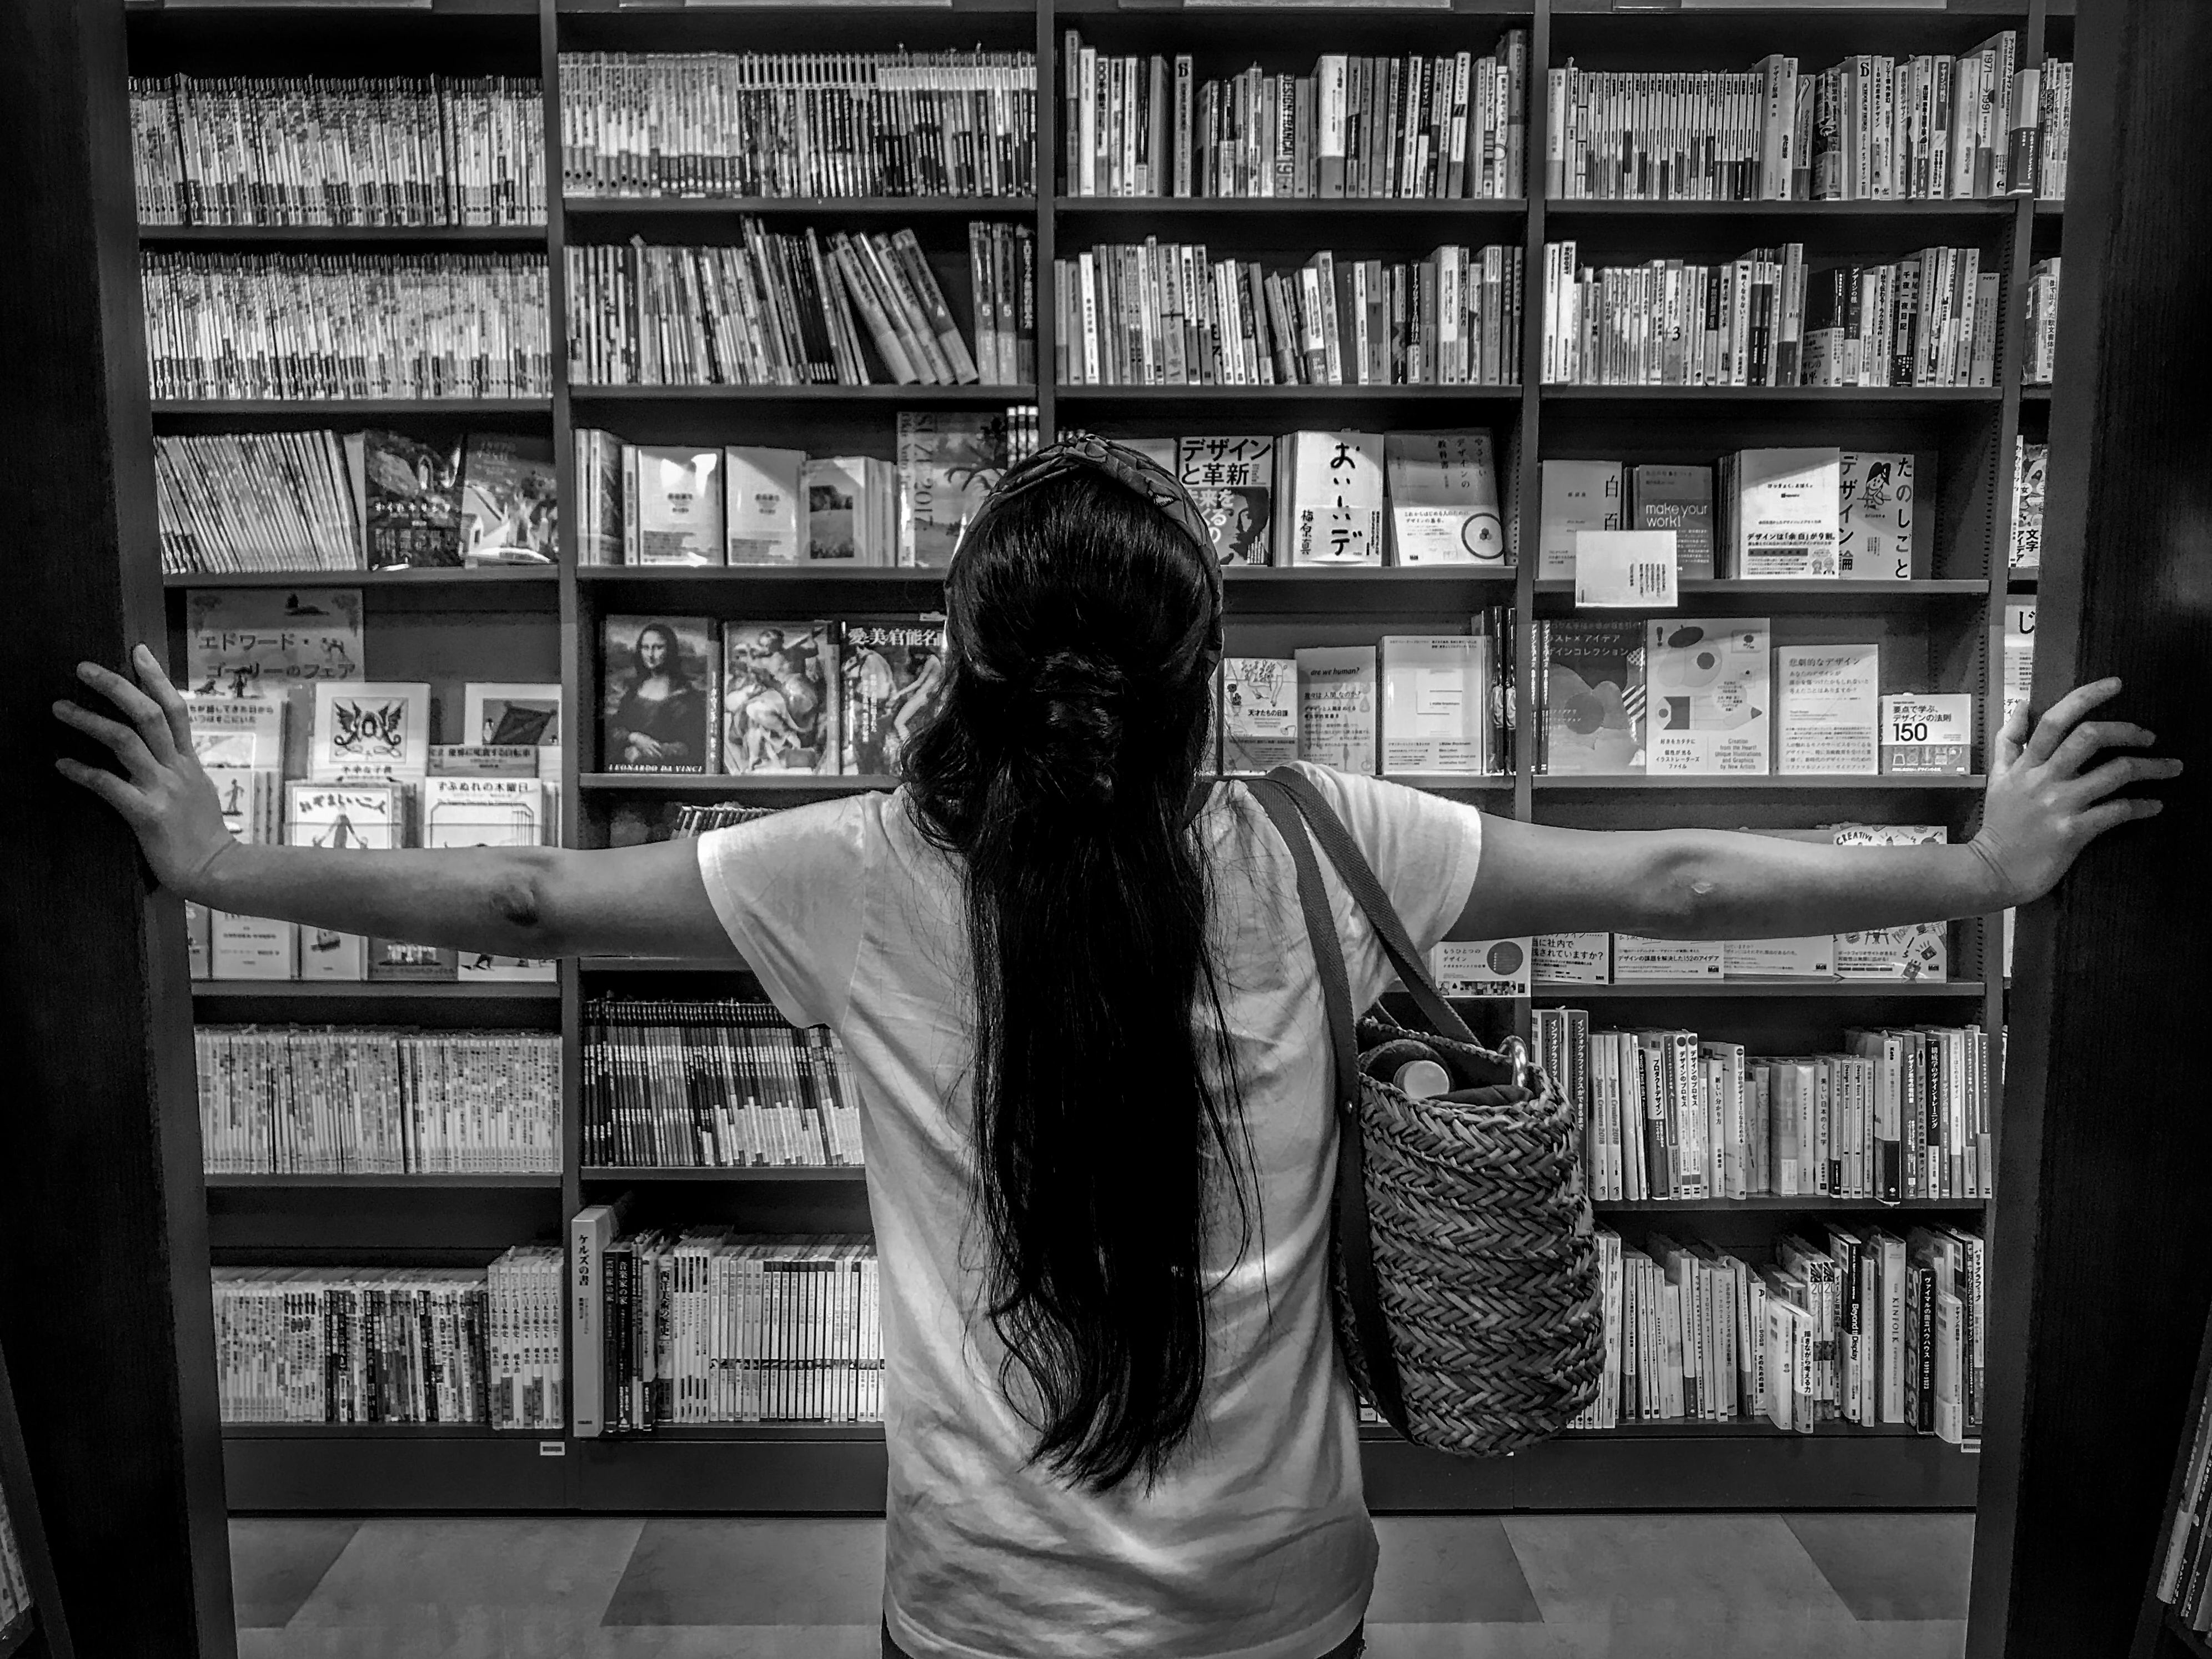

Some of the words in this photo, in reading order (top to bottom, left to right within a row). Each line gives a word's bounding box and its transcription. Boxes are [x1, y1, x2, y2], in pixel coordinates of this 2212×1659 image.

[1983, 53, 1993, 73] 1971
[1182, 438, 1271, 462] デザイン
[1181, 462, 1250, 486] と革新
[1646, 502, 1679, 515] make
[1681, 504, 1708, 518] your
[1646, 515, 1681, 527] work!
[1895, 457, 1913, 579] たのしごと
[2026, 529, 2039, 552] 文字
[199, 632, 309, 652] エドワード・
[1789, 658, 1860, 666] 悲劇的なデザイン
[1893, 705, 1938, 713] 要点で学ぶ、
[1893, 713, 1952, 722] デザインの法則
[1893, 723, 1928, 742] 150
[675, 764, 703, 773] VINCI
[1595, 1077, 1604, 1097] Japan
[1609, 1077, 1617, 1098] Japan
[1653, 1059, 1662, 1116] プロダクトデザイン
[1679, 1051, 1688, 1107] デザインのプロセス
[1690, 1050, 1698, 1106] デザインのプロセス
[1597, 1099, 1605, 1127] Creators
[578, 1234, 589, 1286] ケルズの書
[1850, 1303, 1859, 1330] Beyond
[1850, 1336, 1859, 1361] Display
